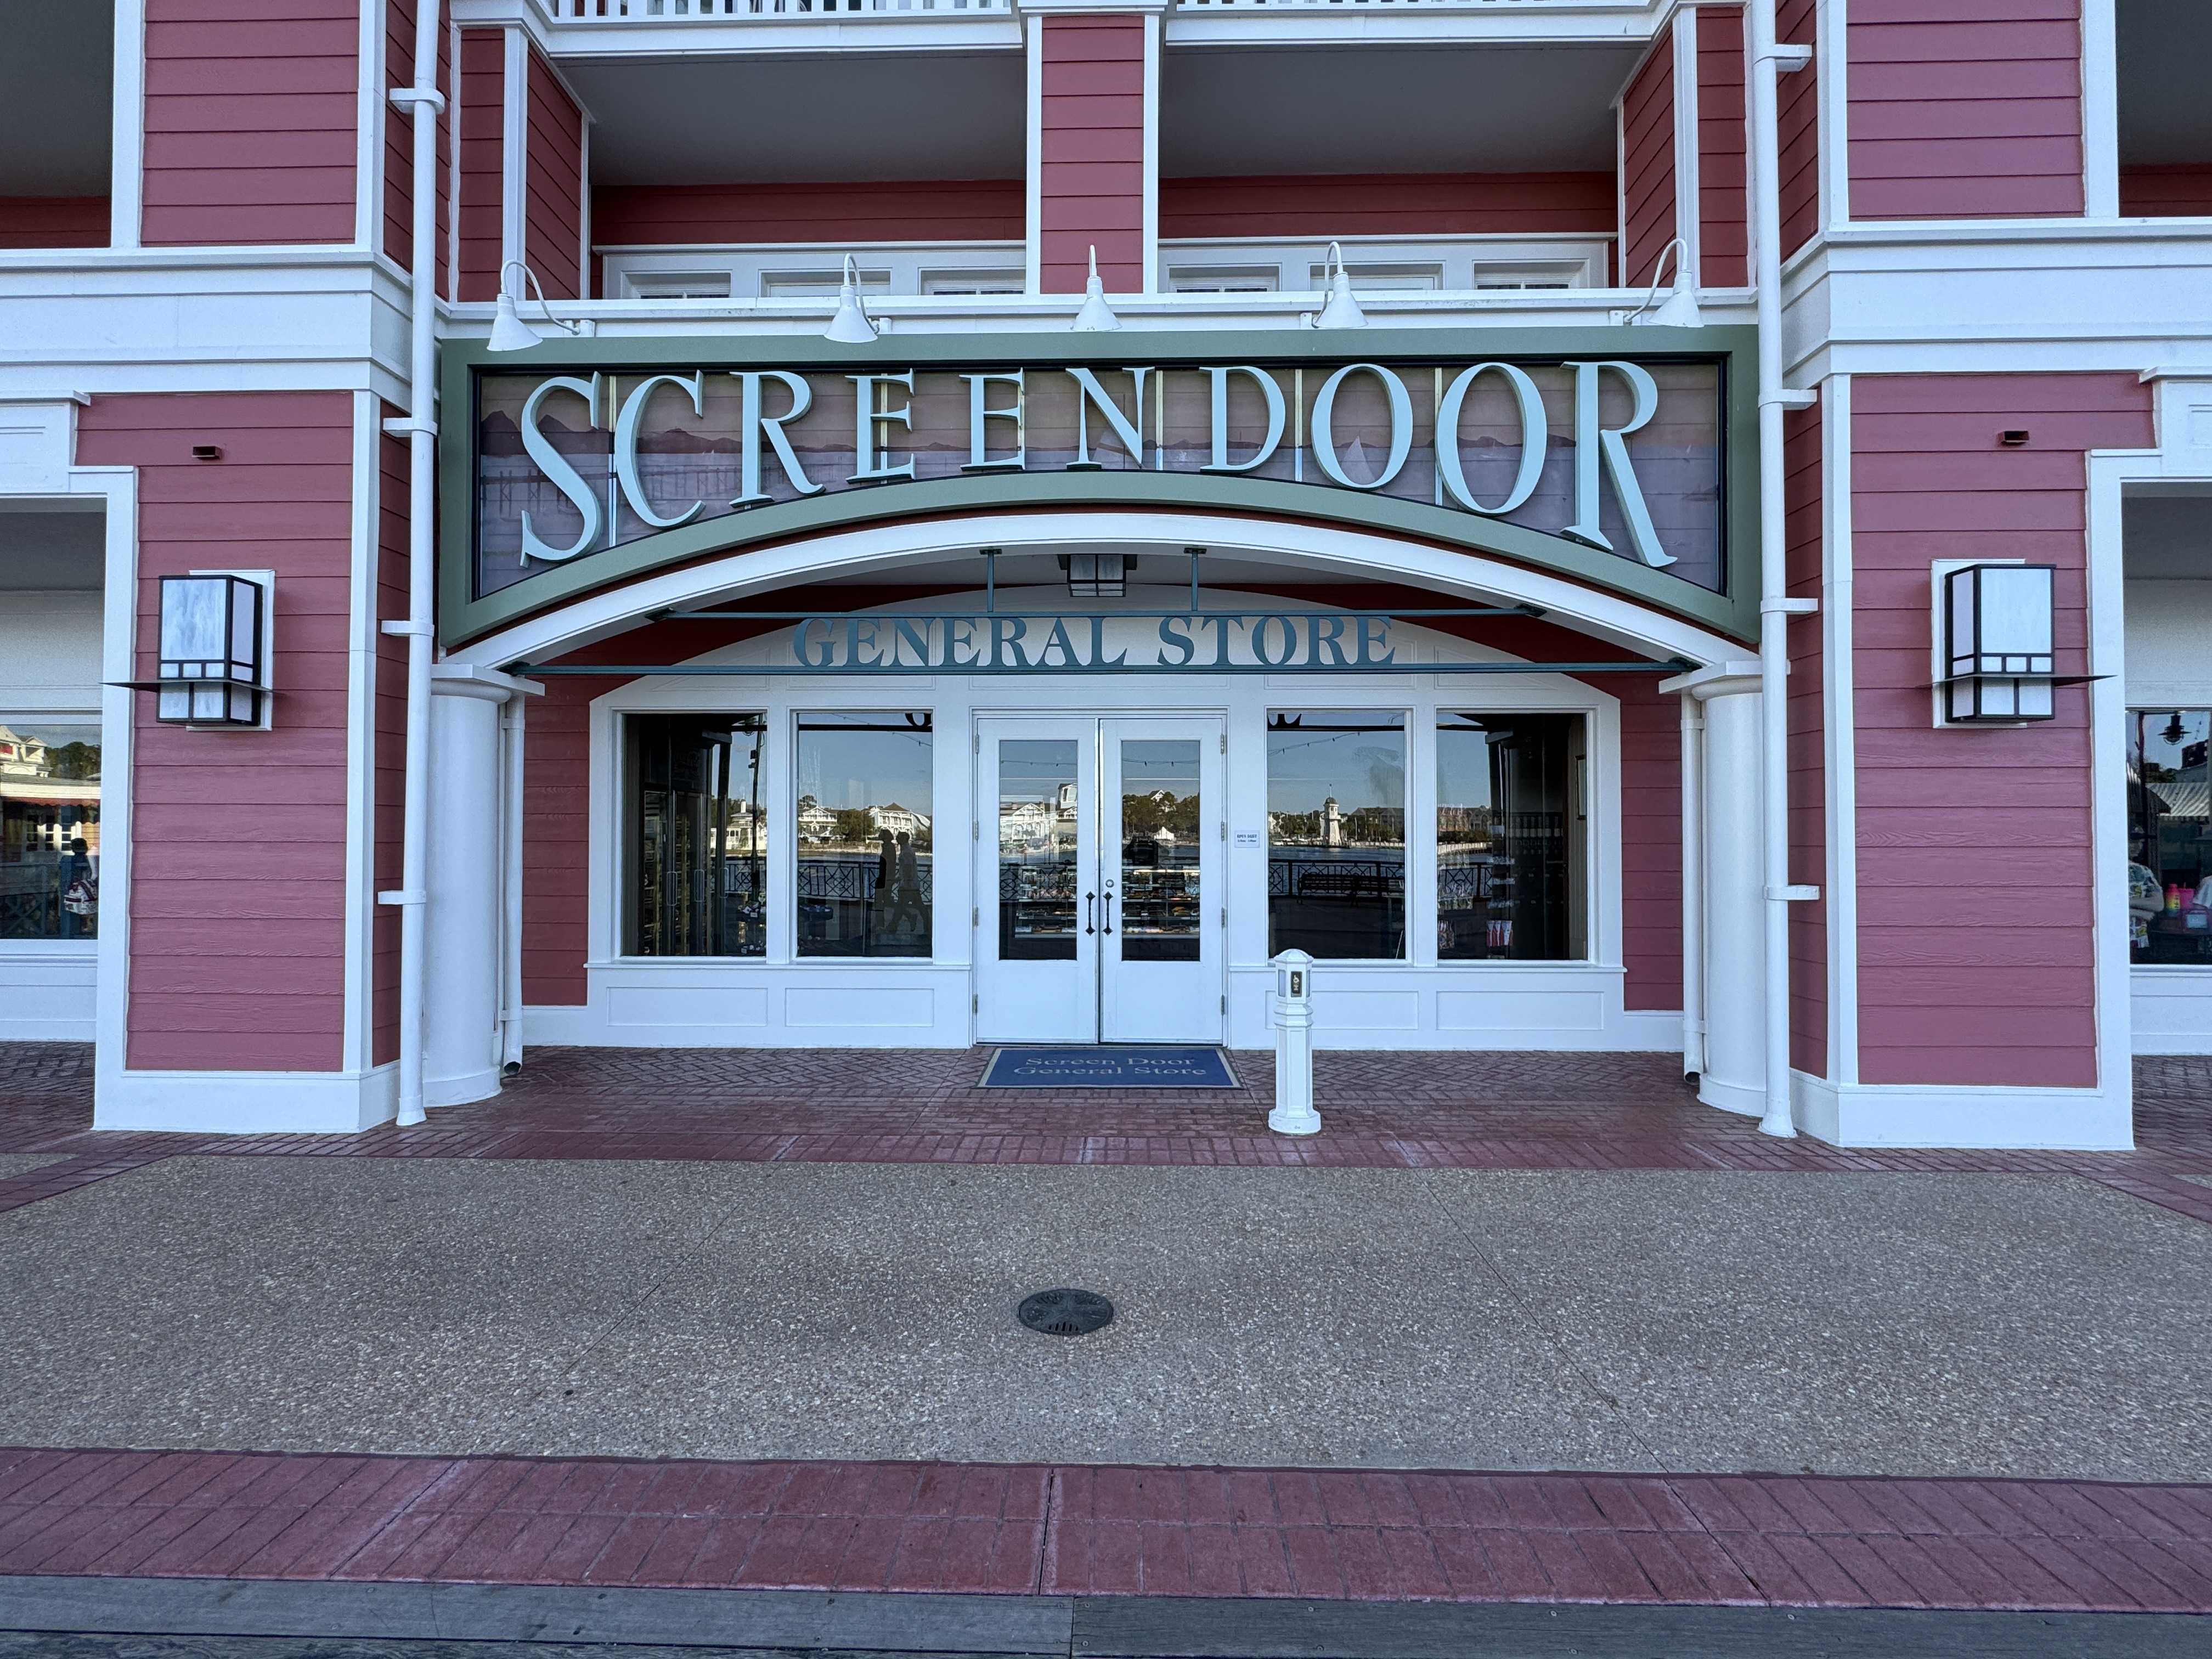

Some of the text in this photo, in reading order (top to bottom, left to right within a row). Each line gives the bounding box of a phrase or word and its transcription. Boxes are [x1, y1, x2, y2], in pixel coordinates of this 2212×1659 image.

[793, 616, 1396, 667] GENERAL STORE
[1126, 1057, 1195, 1065] Door
[1013, 1066, 1207, 1075] General Store
